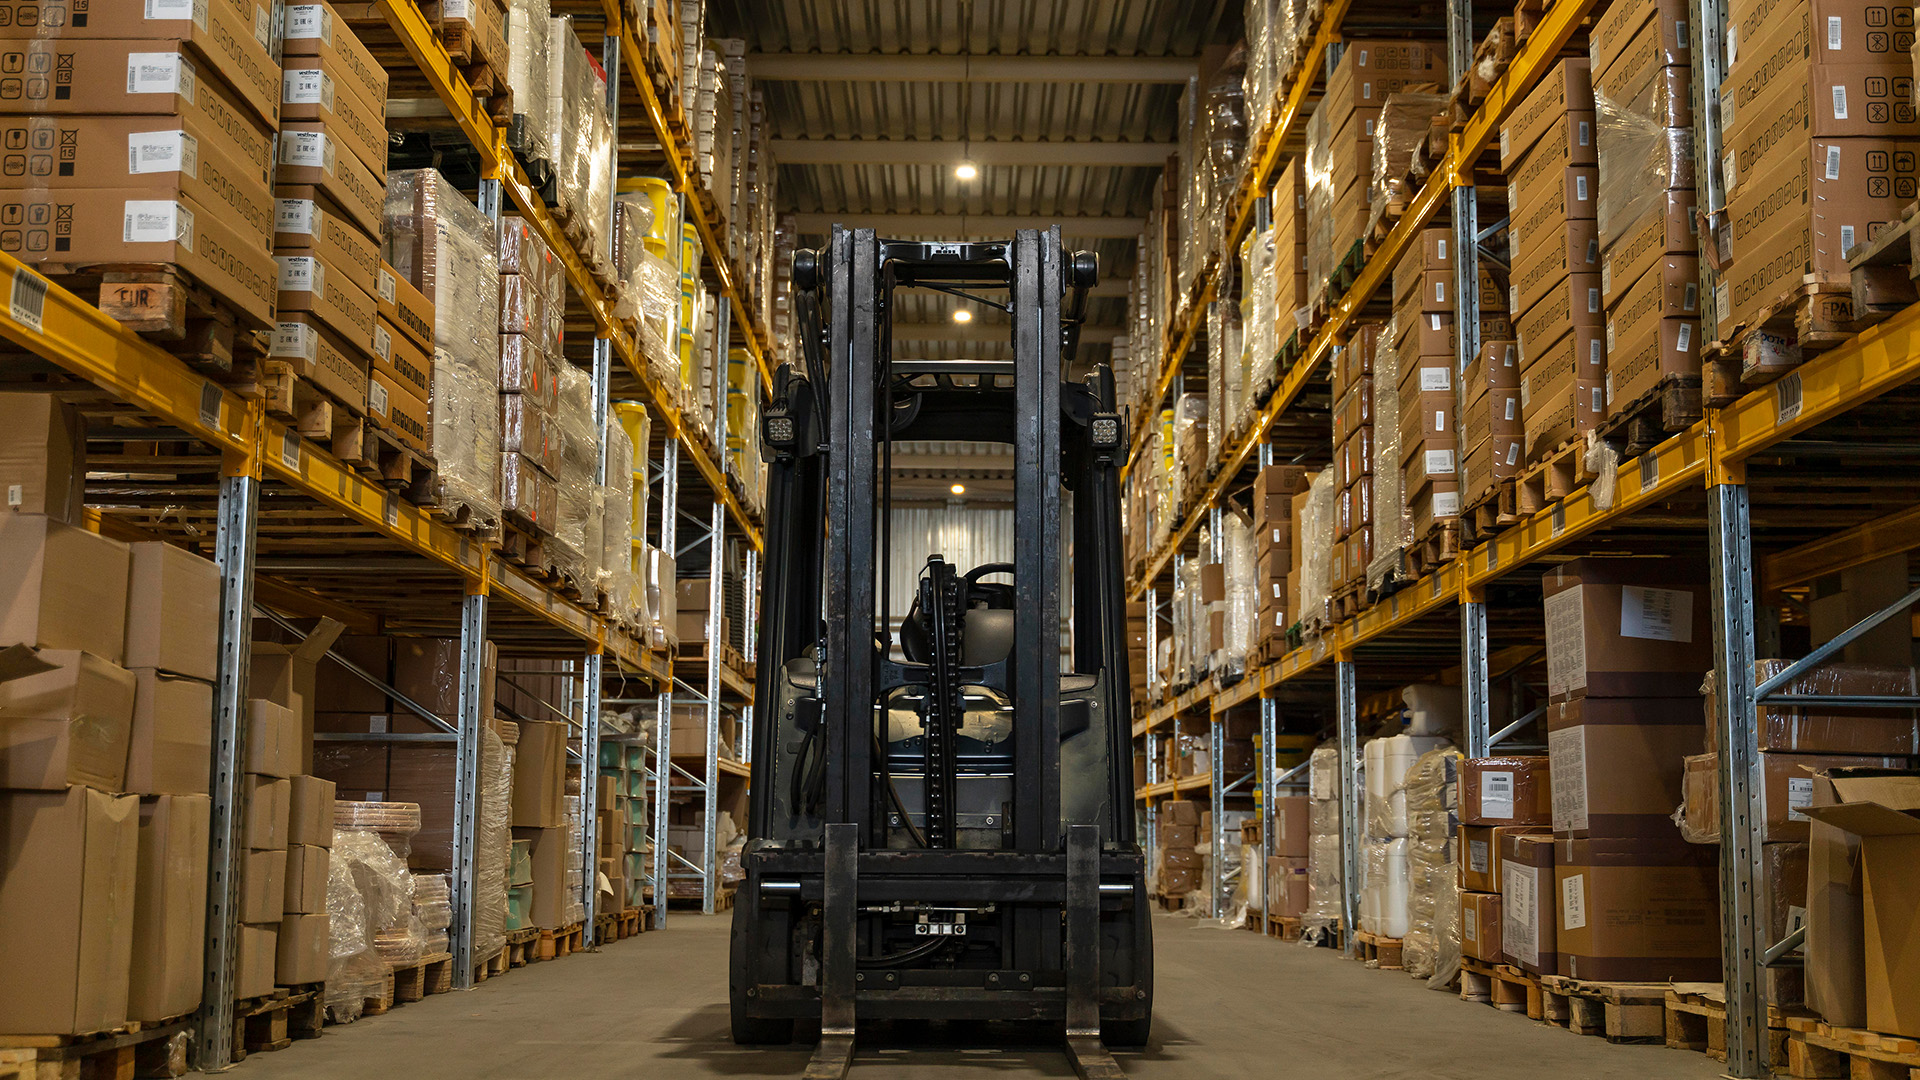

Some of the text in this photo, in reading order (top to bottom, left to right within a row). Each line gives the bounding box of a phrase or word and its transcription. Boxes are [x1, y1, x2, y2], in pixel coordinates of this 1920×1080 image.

[75, 1, 87, 9] 15
[59, 73, 71, 81] 15
[62, 149, 74, 157] 15
[58, 223, 70, 232] 15
